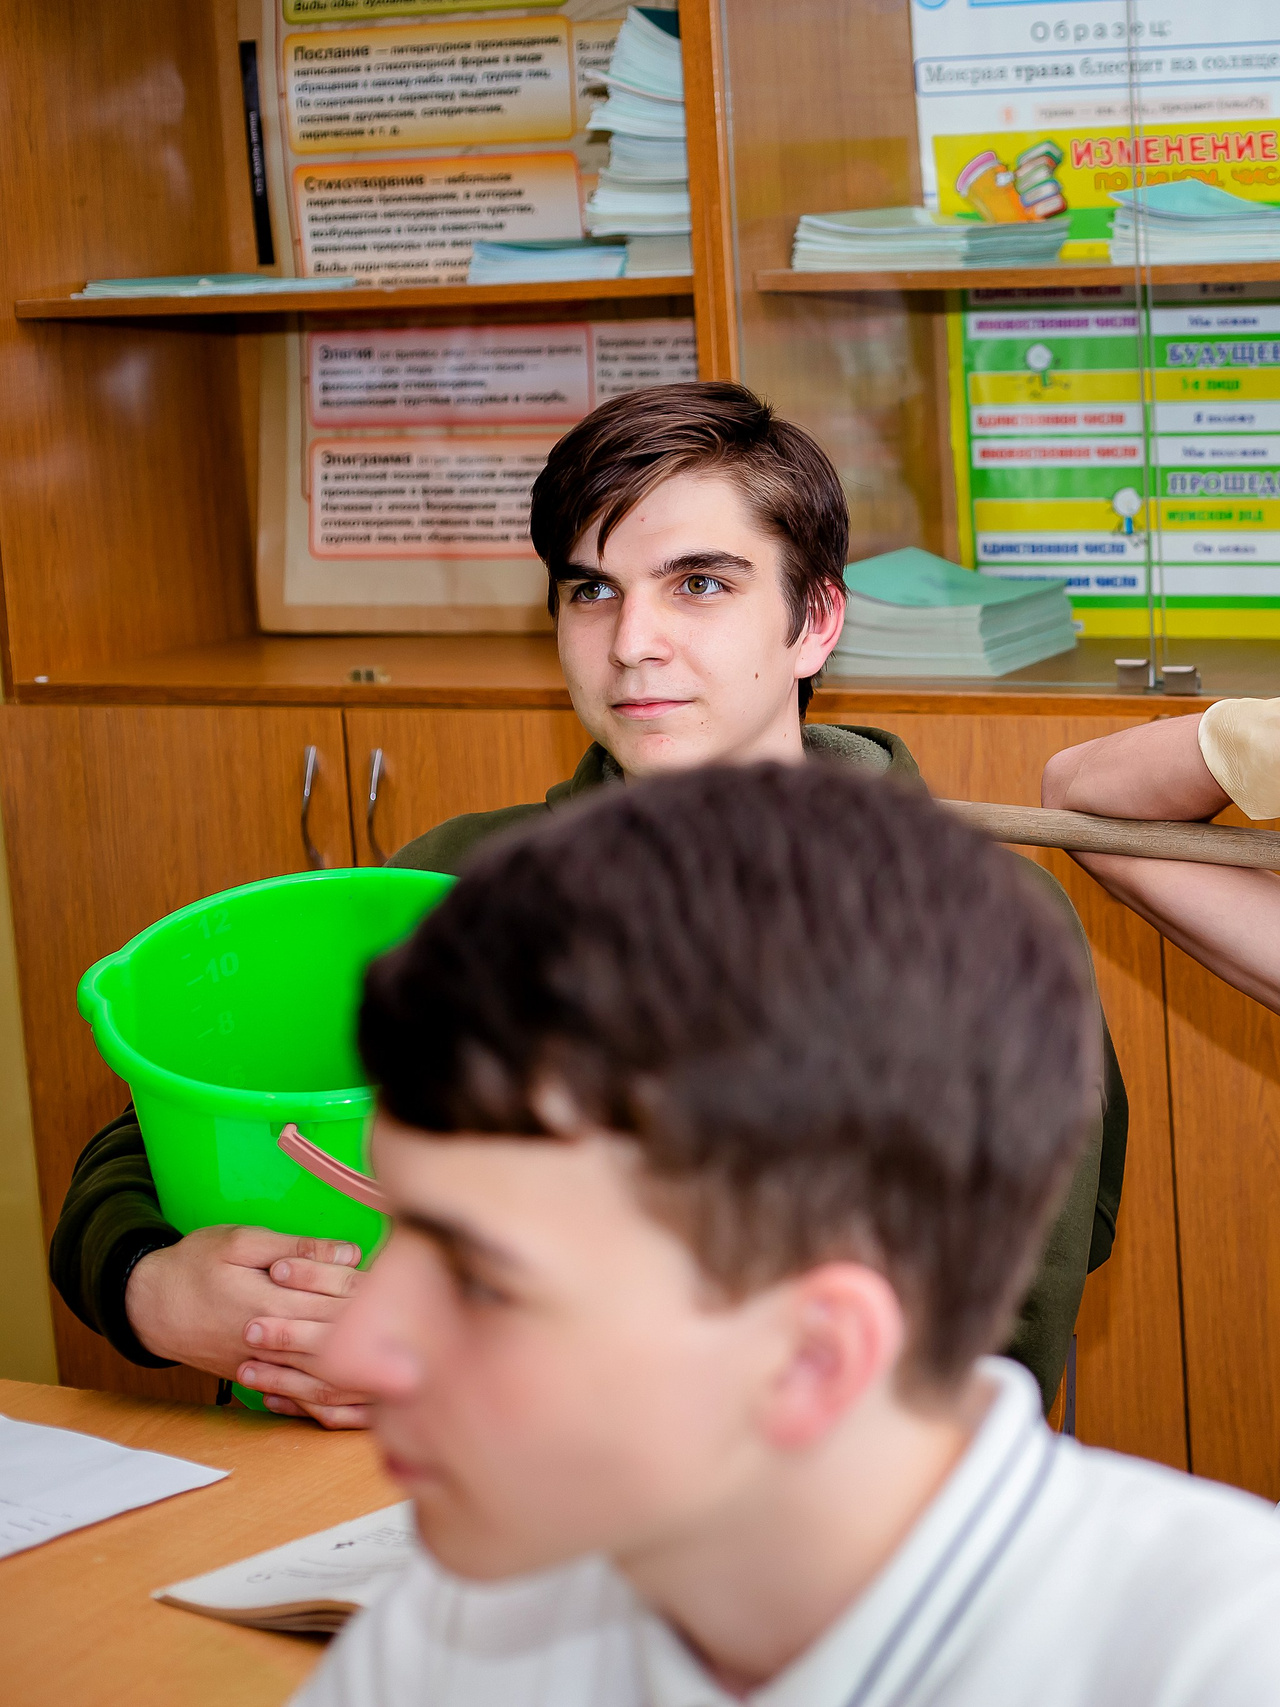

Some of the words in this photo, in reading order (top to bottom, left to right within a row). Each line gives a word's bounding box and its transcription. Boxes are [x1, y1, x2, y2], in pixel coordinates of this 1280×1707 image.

[294, 44, 370, 61] Послание
[925, 63, 1008, 85] Мокрая
[1014, 63, 1075, 82] трава
[1170, 58, 1197, 71] на
[1072, 130, 1279, 168] ИЗМЕНЕНИЕ
[304, 175, 425, 193] Стихотворение
[322, 451, 411, 467] Эпиграмма
[198, 908, 232, 939] 12
[205, 951, 239, 984] 10
[218, 1010, 235, 1036] 8
